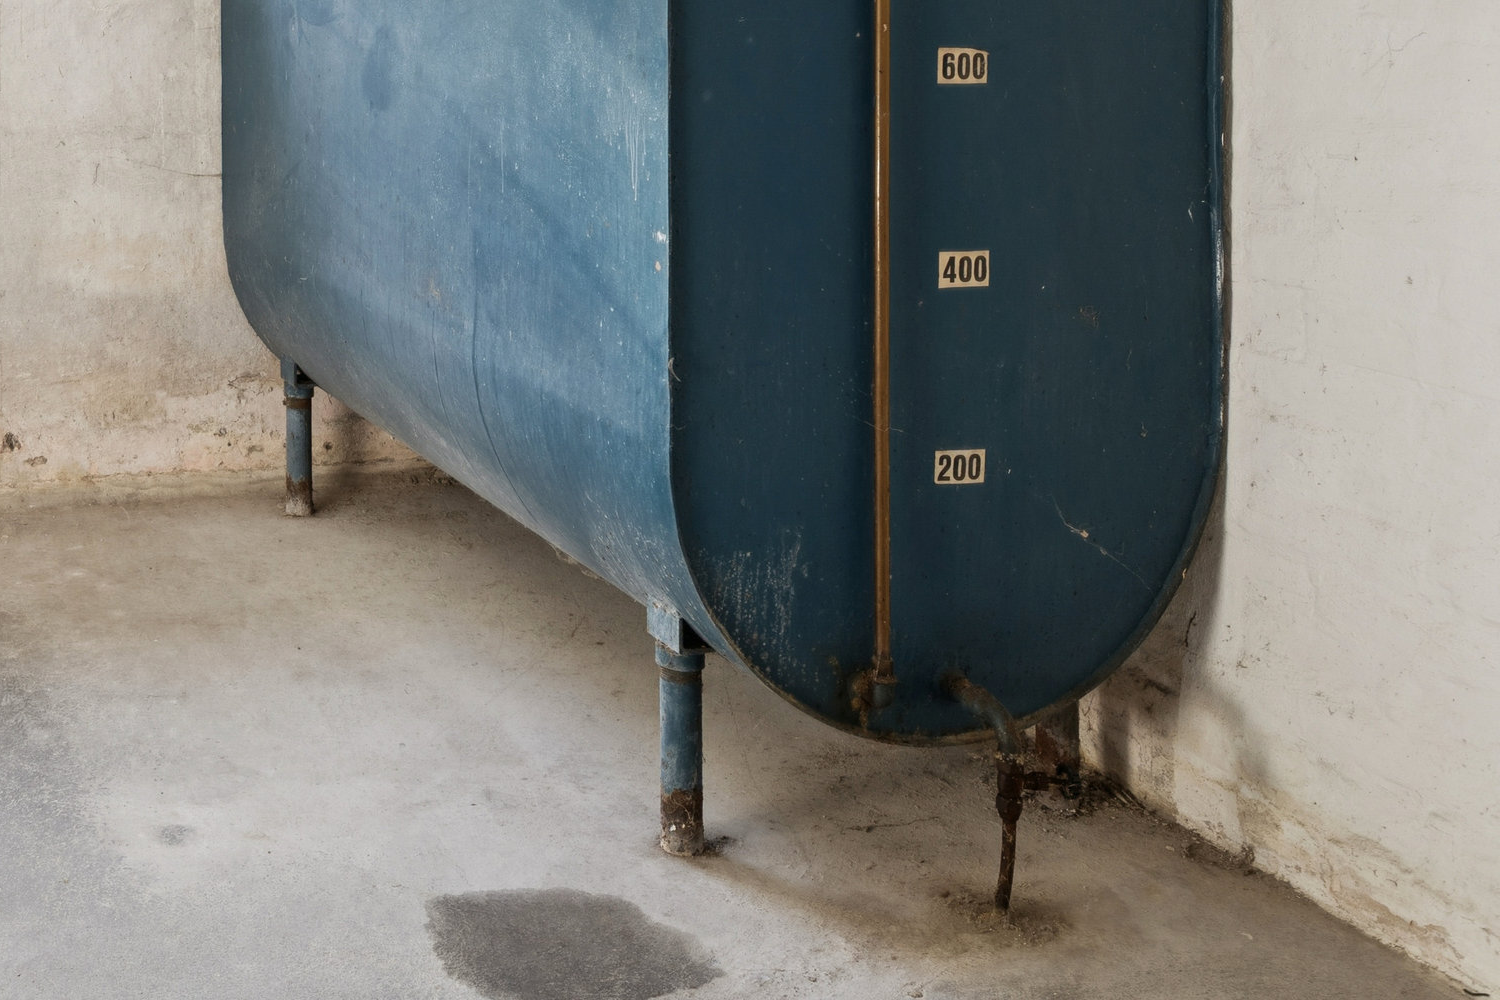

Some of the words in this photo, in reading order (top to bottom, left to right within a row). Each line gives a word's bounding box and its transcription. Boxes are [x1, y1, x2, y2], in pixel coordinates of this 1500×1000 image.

[942, 53, 985, 80] 600
[943, 255, 986, 283] 400
[938, 453, 982, 482] 200
